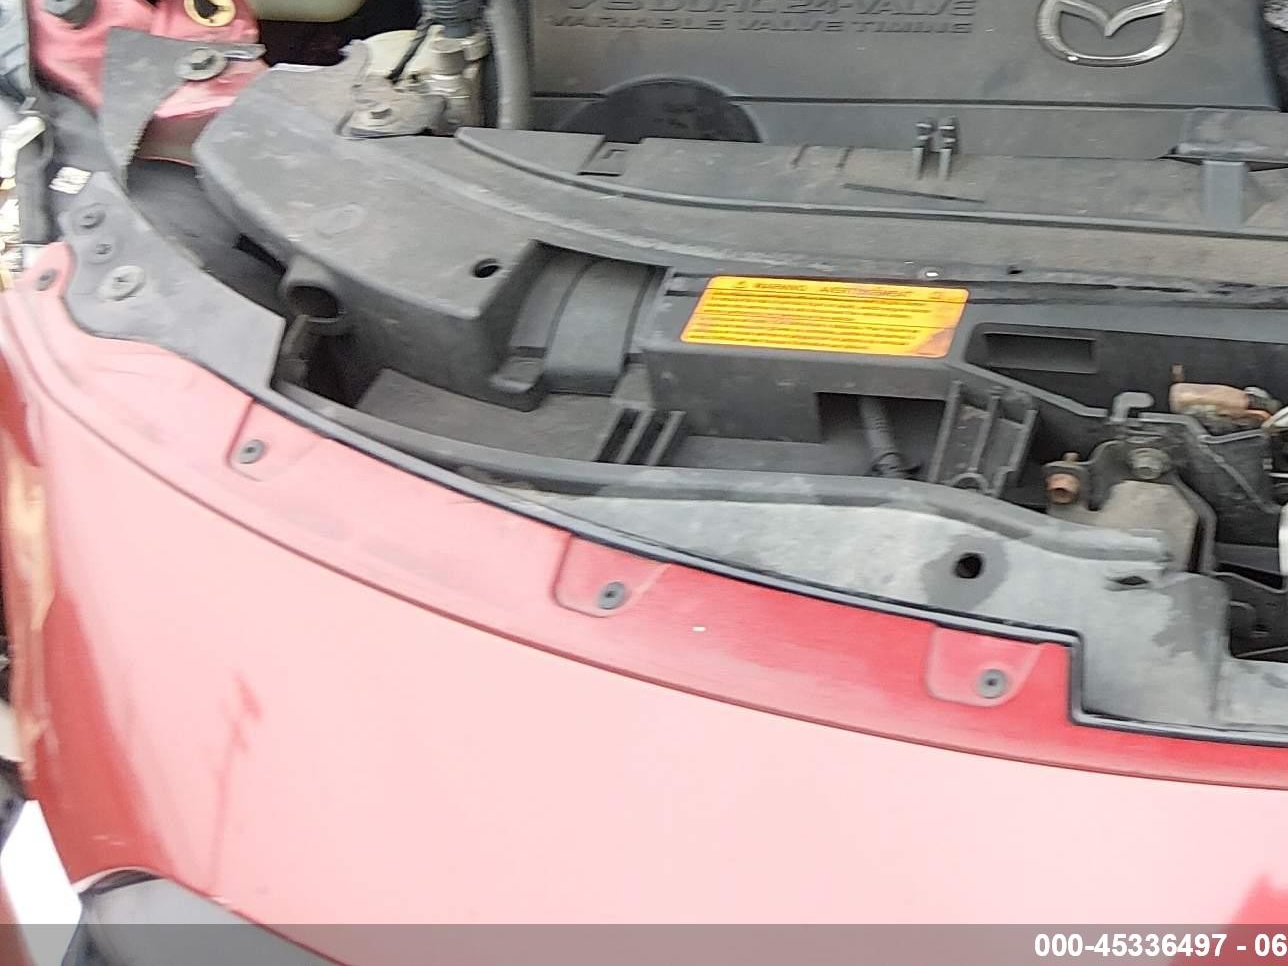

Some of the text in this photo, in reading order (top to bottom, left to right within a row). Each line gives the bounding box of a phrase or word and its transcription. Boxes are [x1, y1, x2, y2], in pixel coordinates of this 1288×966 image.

[549, 15, 974, 35] VARIABLE VALVE TIMING
